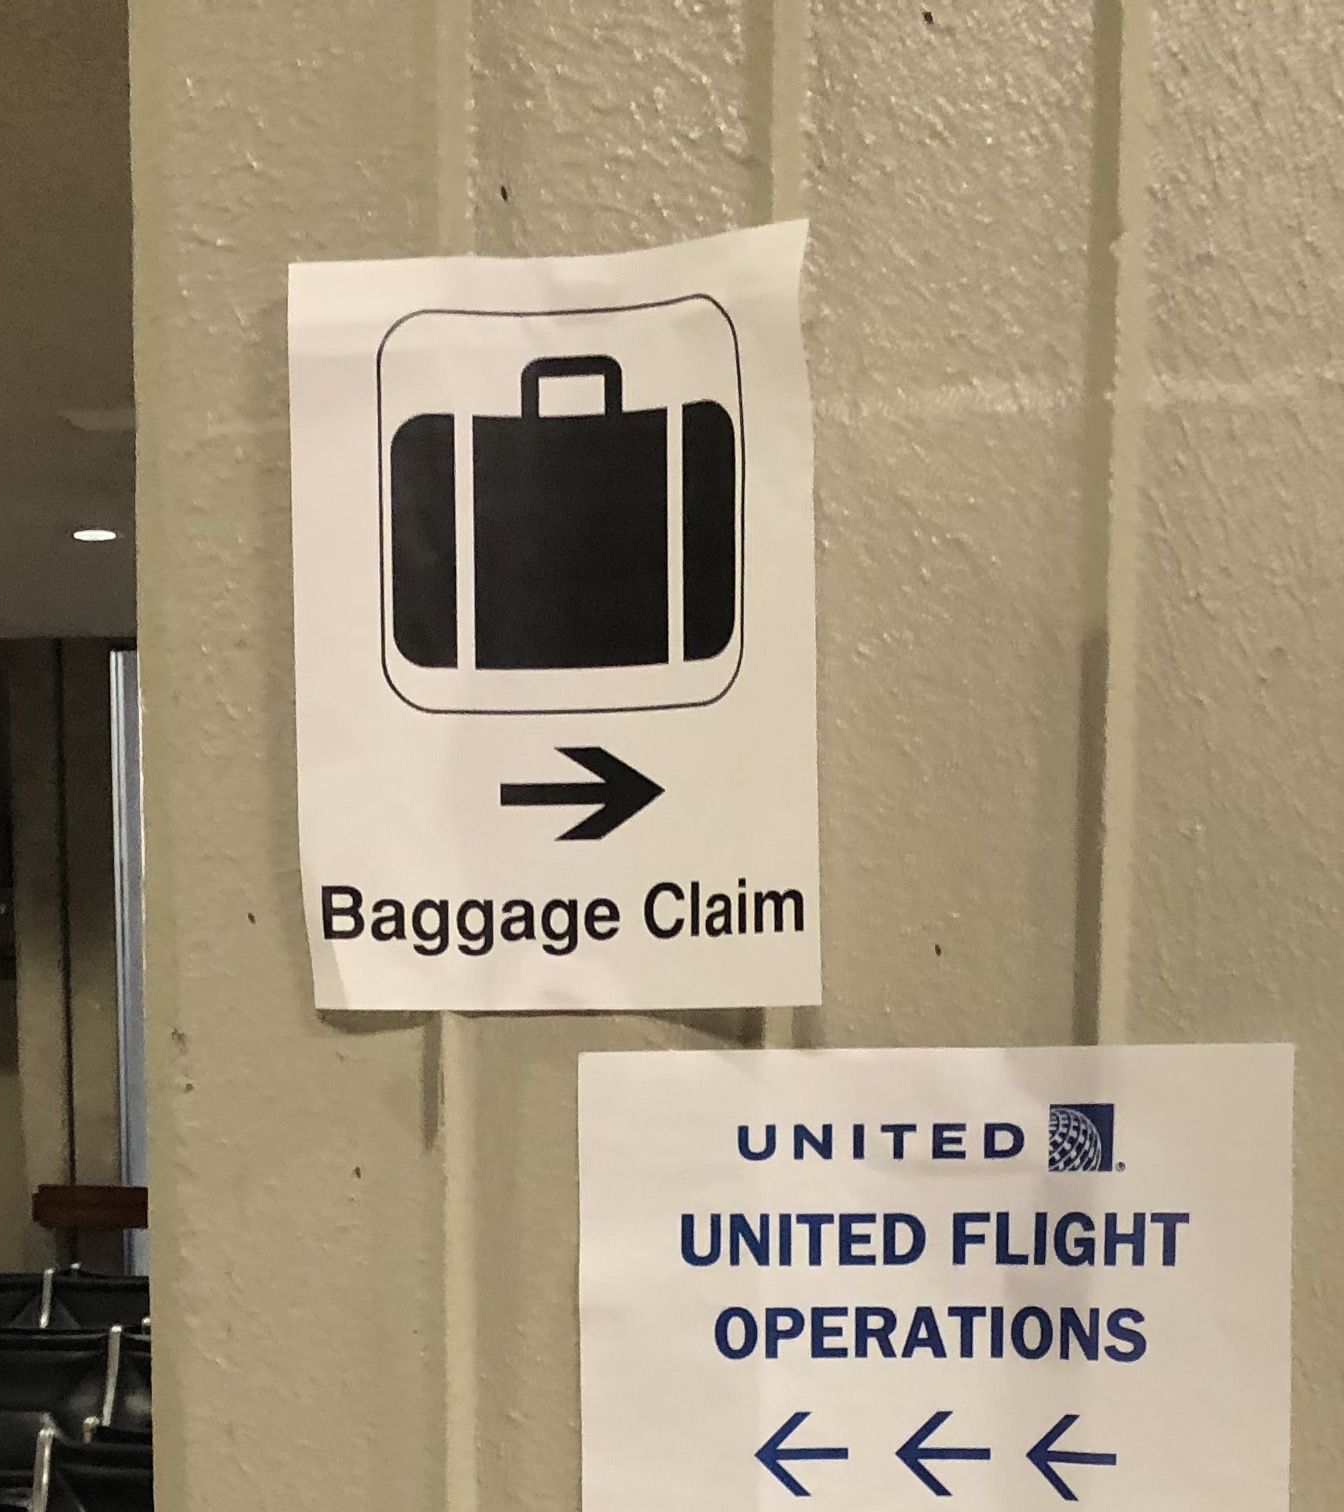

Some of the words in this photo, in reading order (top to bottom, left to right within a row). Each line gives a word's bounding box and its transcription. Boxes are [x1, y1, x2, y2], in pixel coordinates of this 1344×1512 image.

[321, 884, 621, 956] Baggage
[643, 878, 805, 939] Claim
[737, 1122, 1025, 1161] UNITED
[680, 1213, 926, 1267] UNITED
[952, 1211, 1190, 1267] FLIGHT
[714, 1306, 1147, 1363] OPERATIONS
